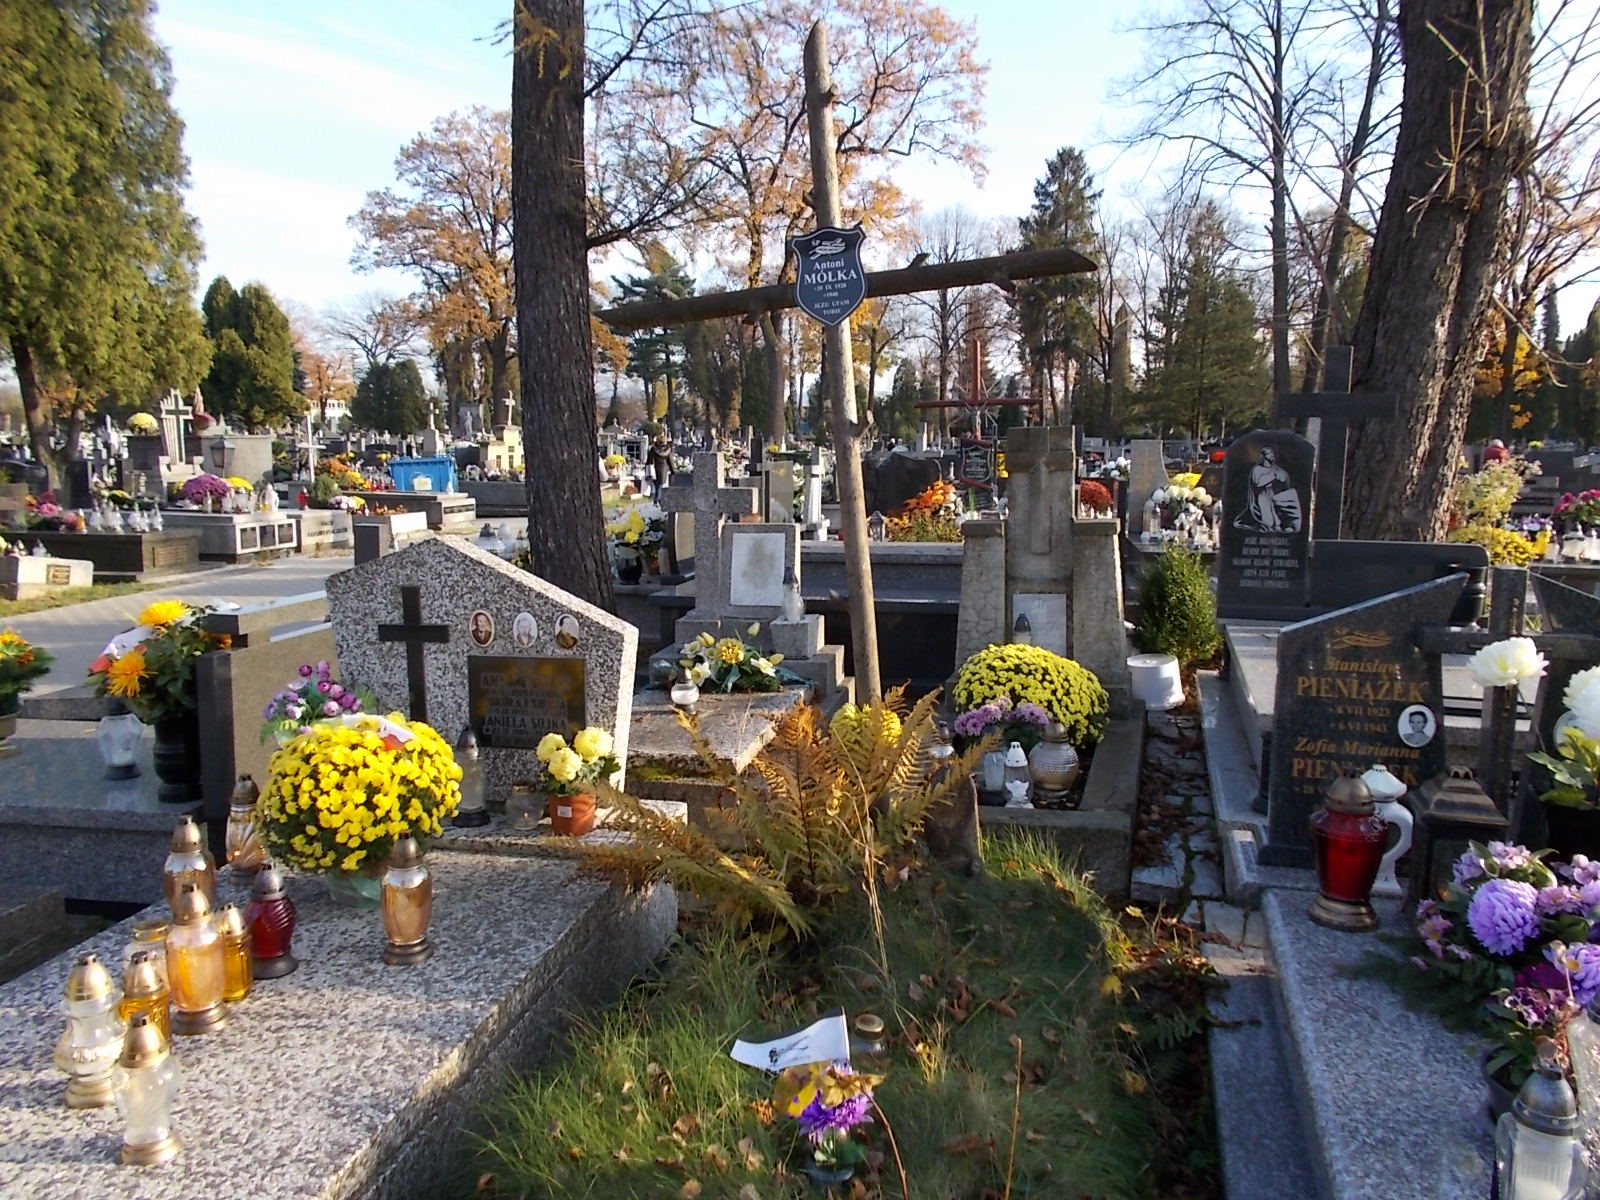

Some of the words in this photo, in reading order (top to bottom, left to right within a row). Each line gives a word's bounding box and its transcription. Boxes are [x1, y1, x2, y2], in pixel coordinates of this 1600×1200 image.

[813, 258, 845, 271] Antoni
[804, 268, 858, 285] MÓLKA
[1324, 656, 1400, 674] Stanisław
[1296, 675, 1429, 705] PIENIĄŻEK
[1294, 736, 1337, 756] Zofia
[1340, 739, 1421, 759] Marianna
